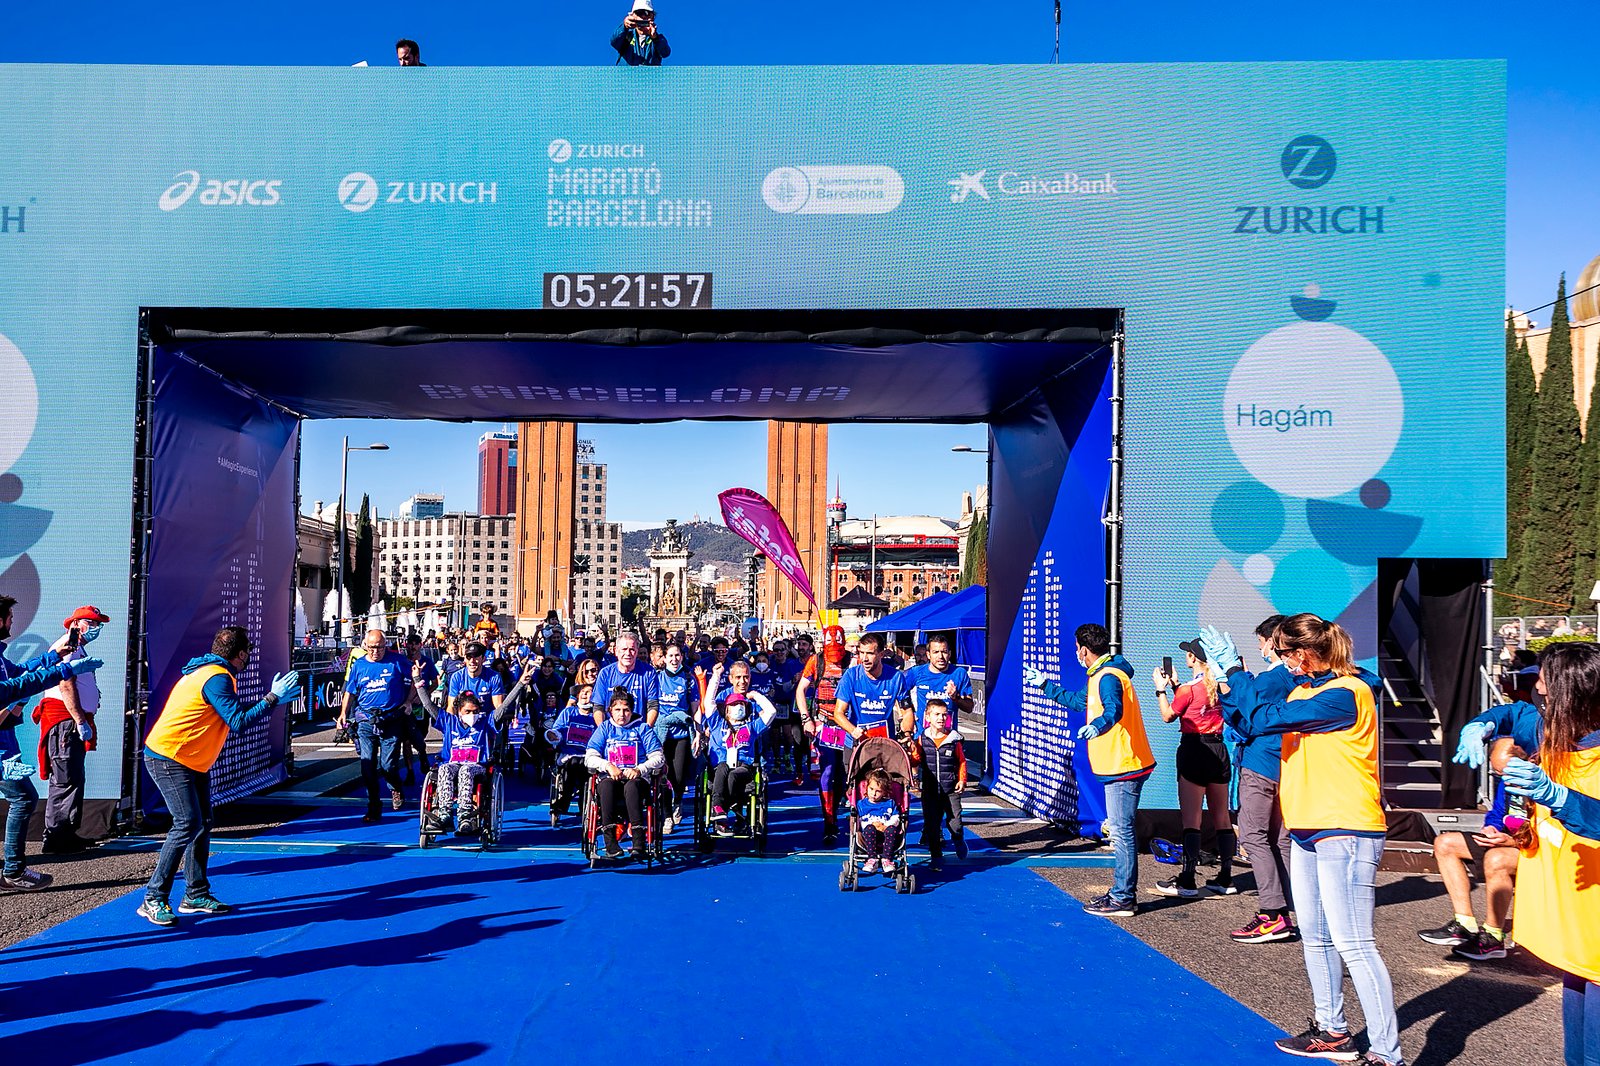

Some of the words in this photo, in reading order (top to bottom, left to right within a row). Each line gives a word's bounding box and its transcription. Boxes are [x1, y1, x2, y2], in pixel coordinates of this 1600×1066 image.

[576, 144, 644, 158] ZURICH
[548, 161, 662, 195] MARATÓ
[998, 171, 1119, 194] CaixaBank
[386, 181, 498, 204] ZURICH
[816, 188, 884, 200] Barcelona
[547, 199, 712, 227] BARCELONA
[1232, 205, 1385, 234] ZURICH
[550, 274, 706, 308] 05:21:57
[419, 384, 851, 403] BARCELONA
[1236, 403, 1333, 432] Hagám
[492, 432, 513, 440] Allianz
